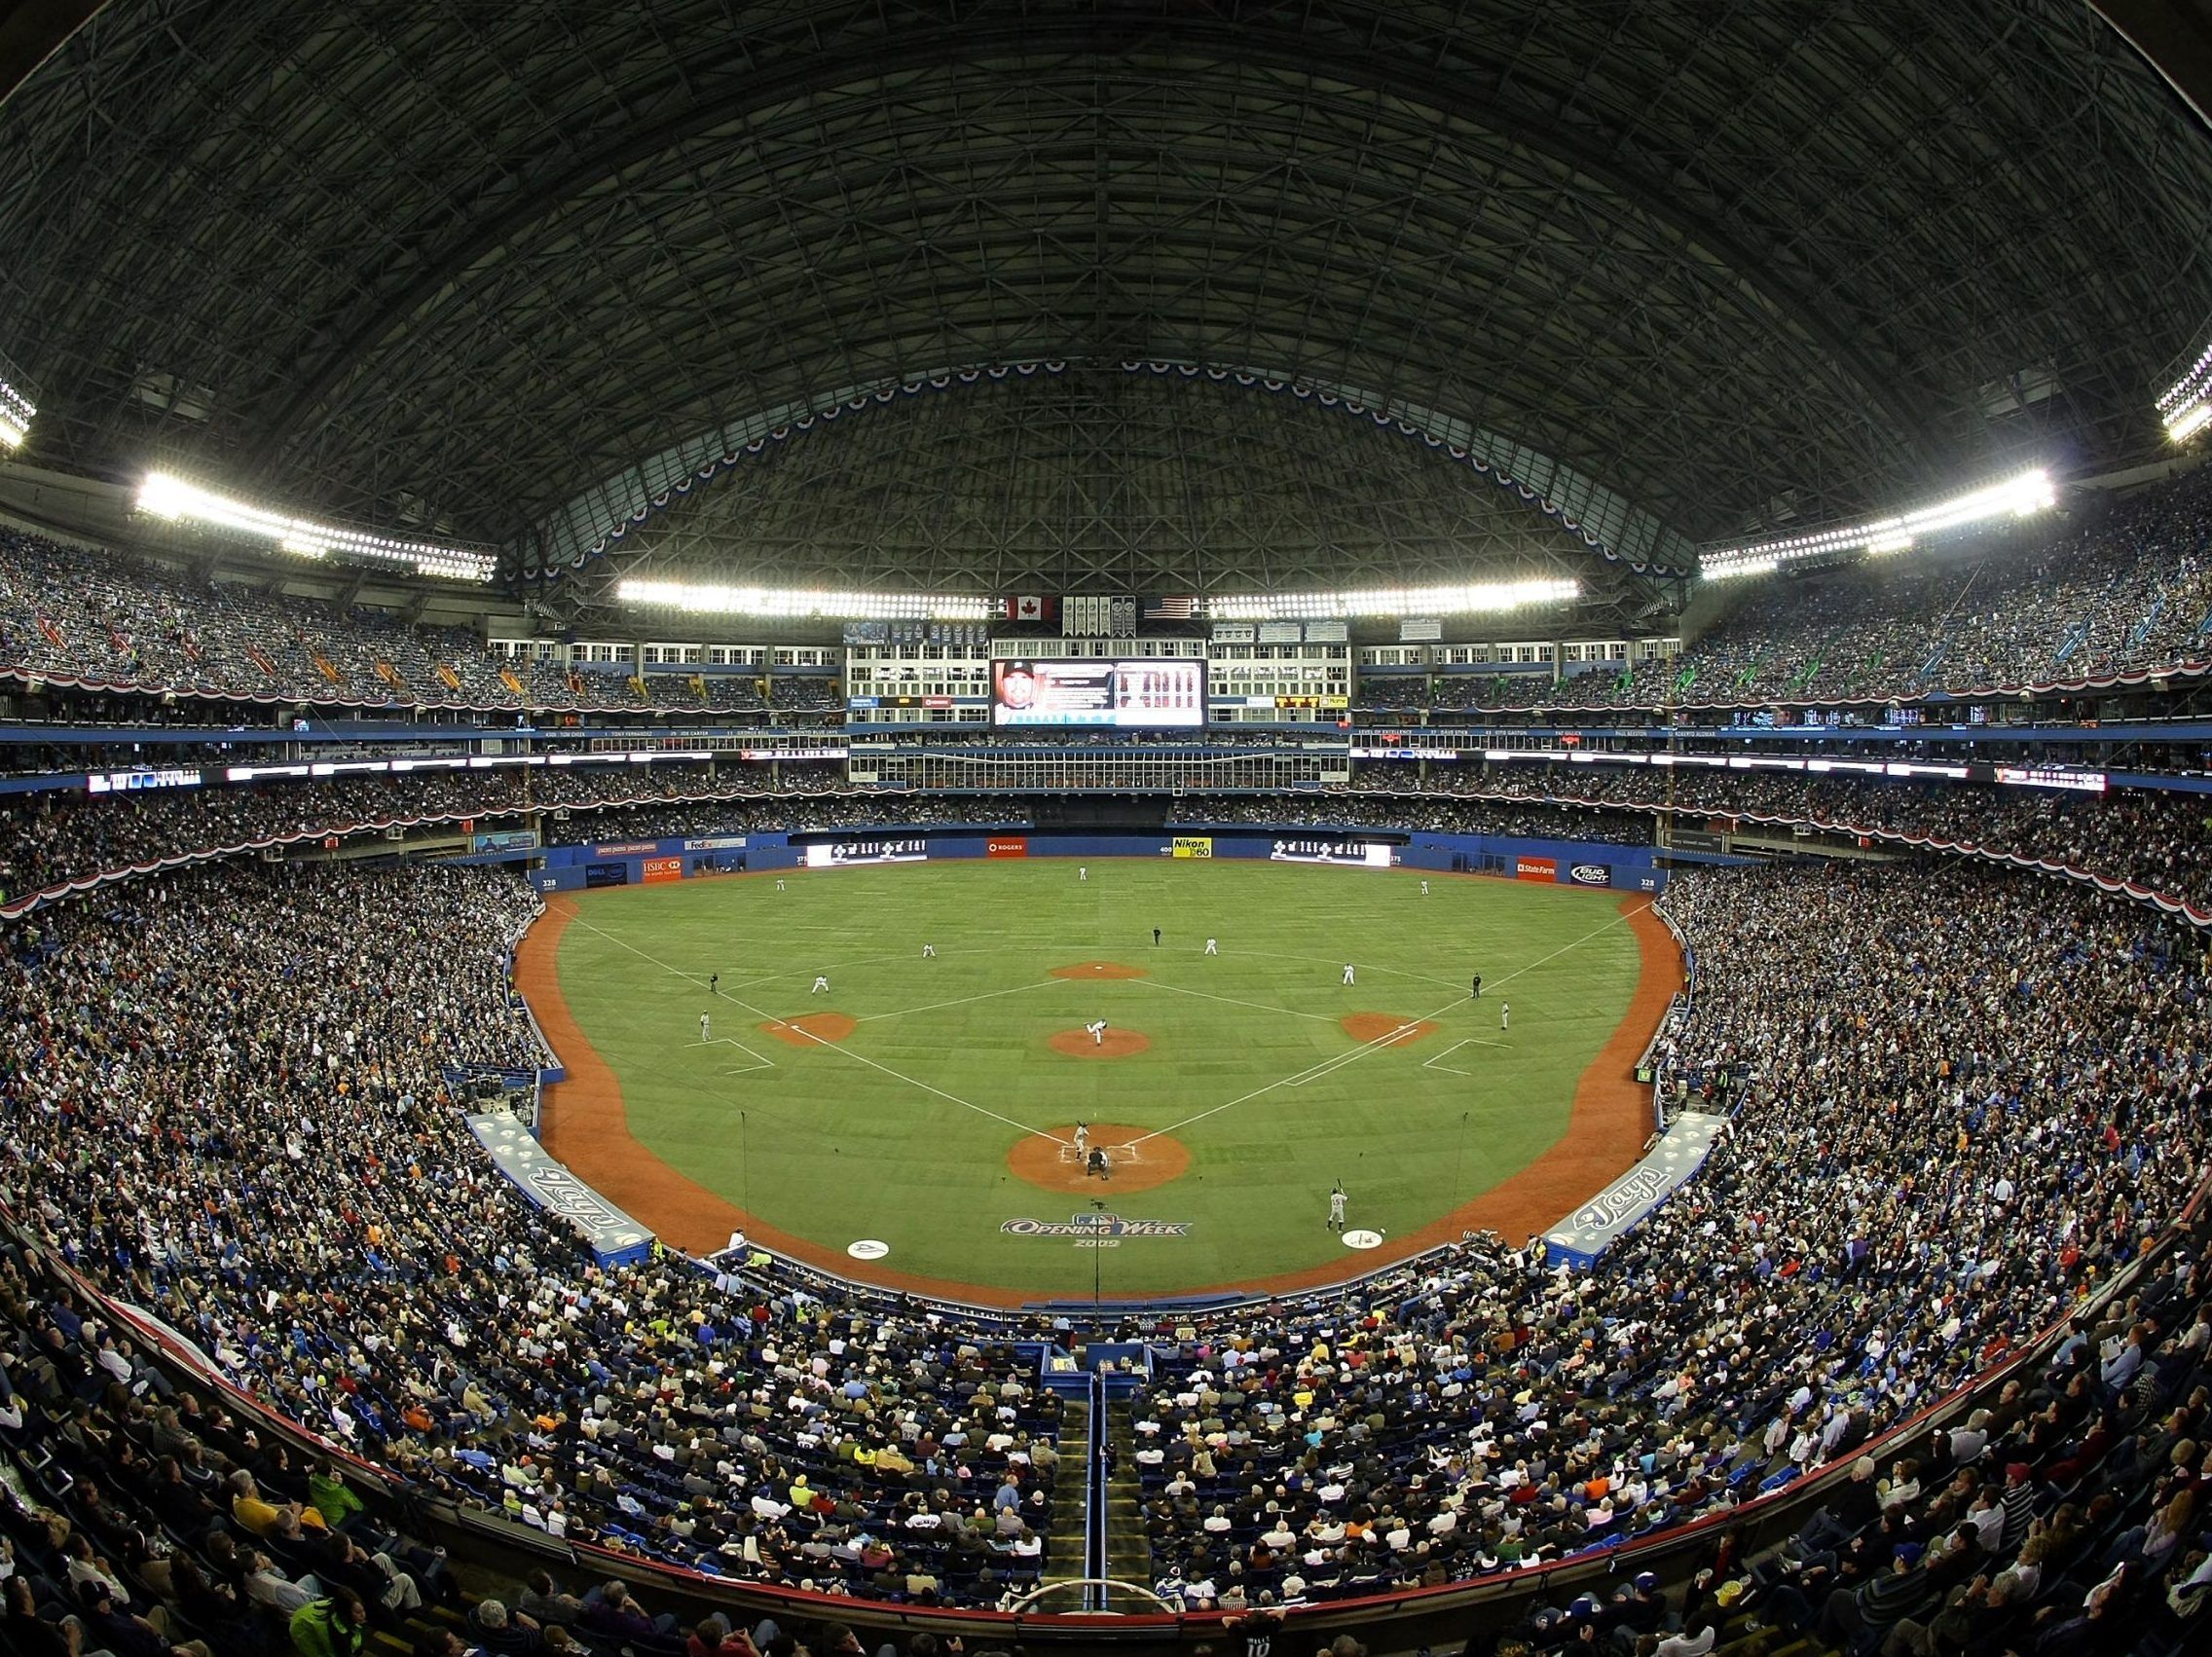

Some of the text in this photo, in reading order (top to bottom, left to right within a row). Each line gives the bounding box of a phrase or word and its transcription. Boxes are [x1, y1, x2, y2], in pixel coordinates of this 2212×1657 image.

[691, 840, 713, 849] FedEx
[1175, 839, 1204, 848] Nikon
[644, 862, 667, 872] HSBC
[1524, 865, 1555, 875] State Farm
[1580, 866, 1605, 875] BUD
[1576, 872, 1609, 881] LIGHT
[1641, 878, 1654, 887] 328
[529, 1167, 629, 1232] Jays
[1573, 1166, 1671, 1230] Jays
[1120, 1221, 1183, 1235] WEEK
[1074, 1238, 1121, 1247] 2009
[1248, 1642, 1270, 1657] 10
